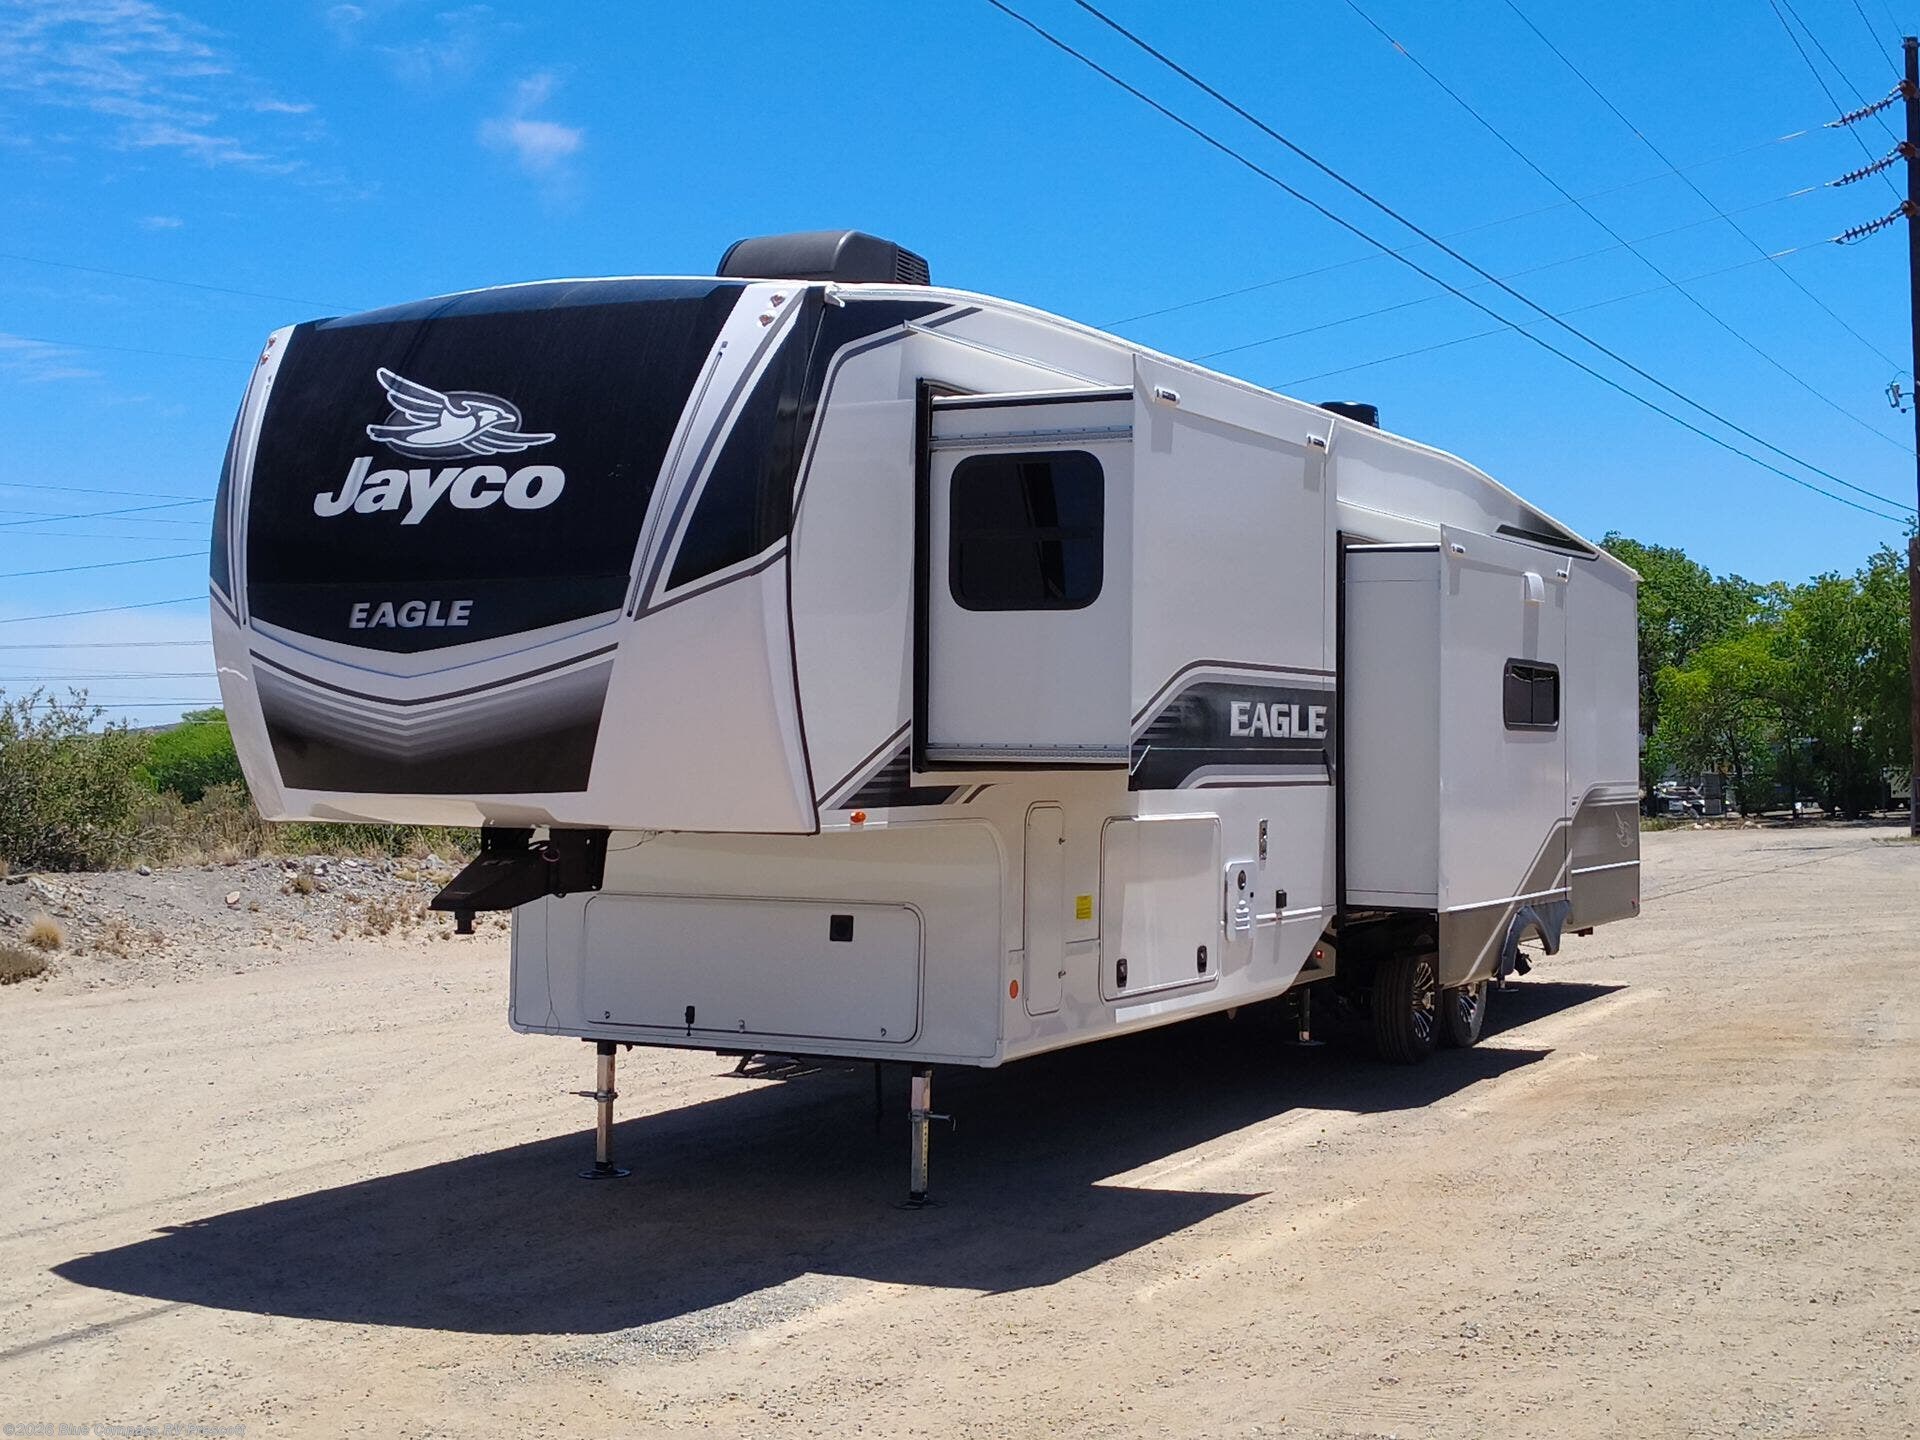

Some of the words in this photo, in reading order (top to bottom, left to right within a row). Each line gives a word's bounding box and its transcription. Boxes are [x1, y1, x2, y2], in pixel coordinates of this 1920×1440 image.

[313, 456, 566, 525] Jayco
[349, 600, 474, 629] EAGLE
[1230, 700, 1328, 739] EAGLE
